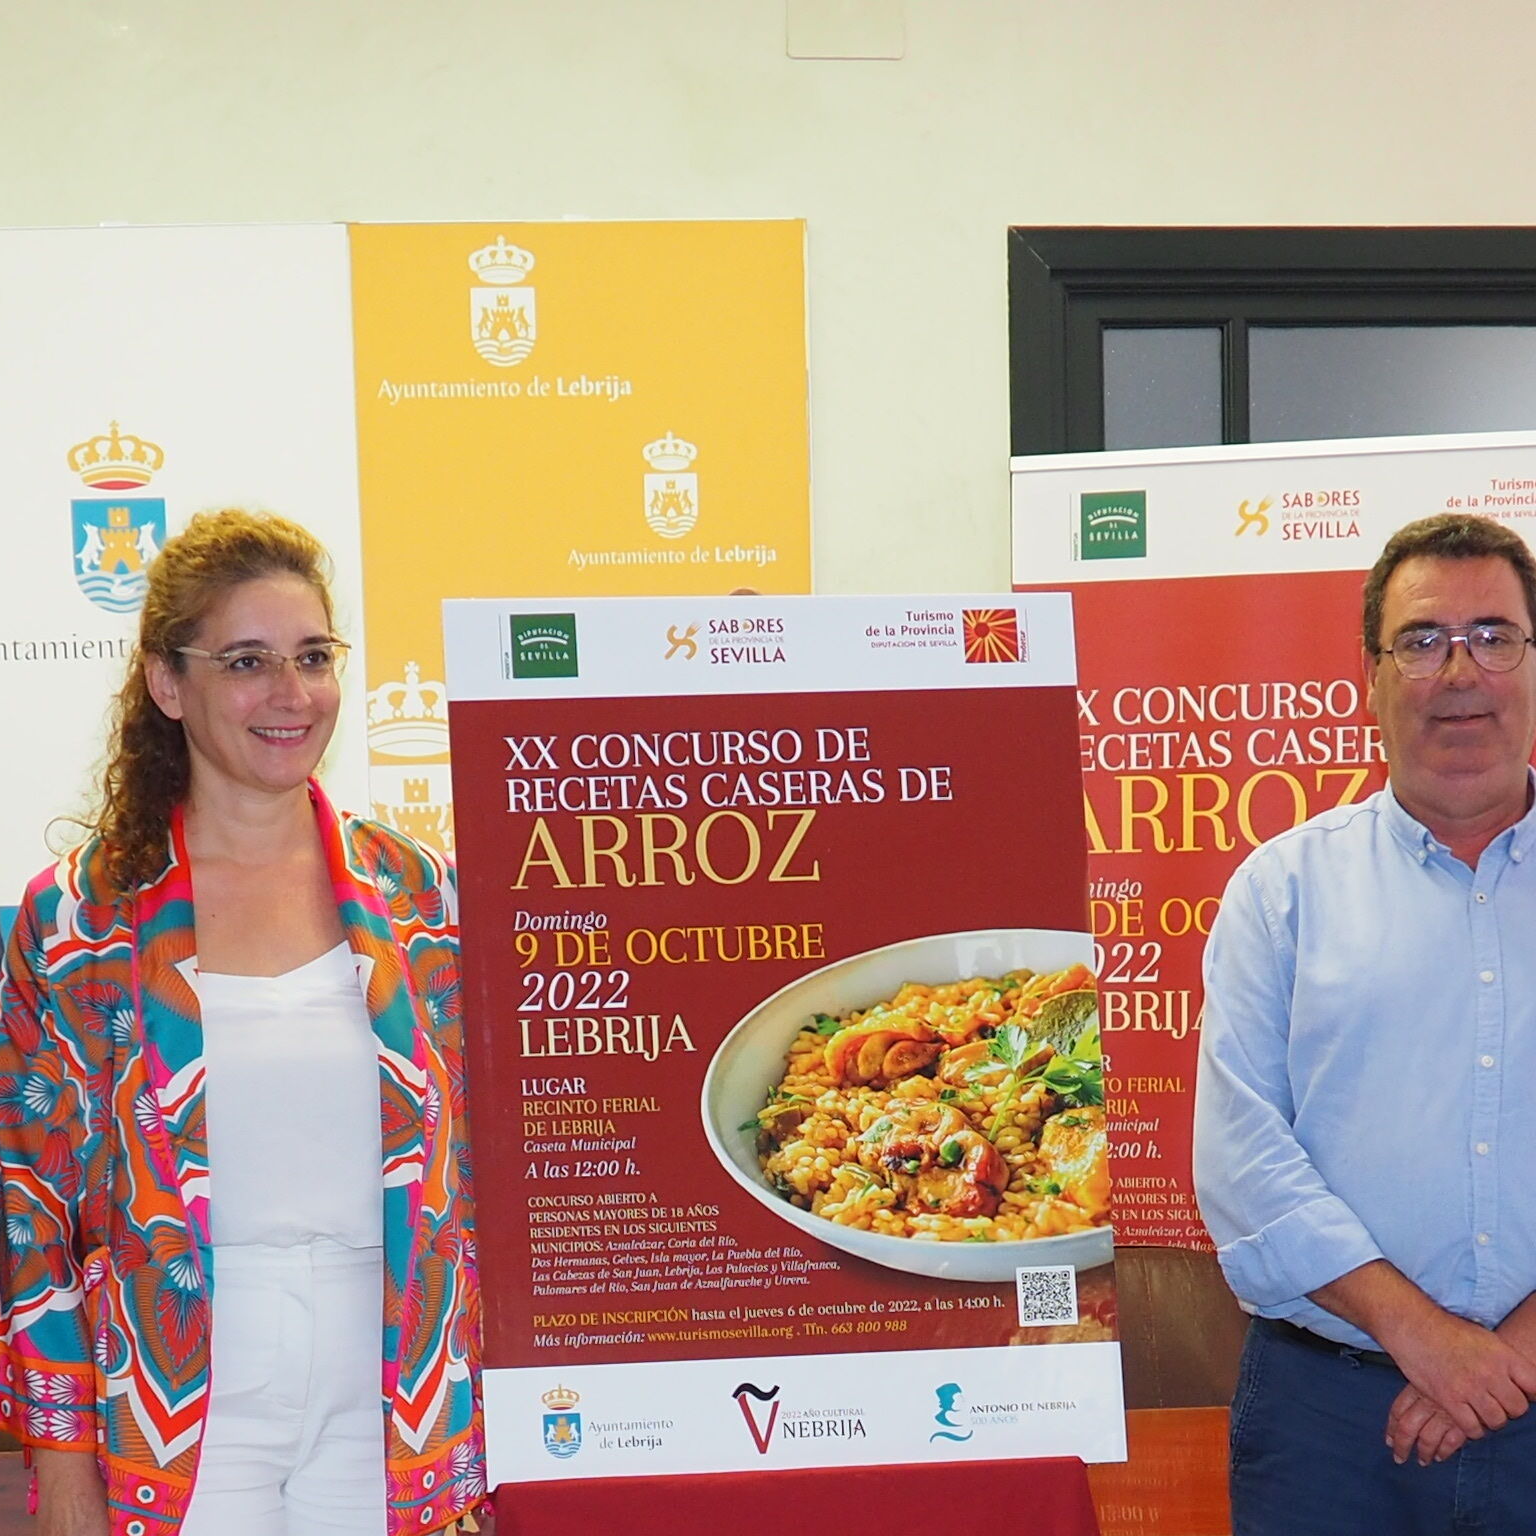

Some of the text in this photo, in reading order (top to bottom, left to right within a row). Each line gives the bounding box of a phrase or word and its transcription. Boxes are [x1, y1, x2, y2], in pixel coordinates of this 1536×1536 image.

[378, 374, 632, 405] Ayuntamiento de Lebrija
[1282, 490, 1361, 509] SABORES
[1447, 498, 1462, 508] de
[1468, 496, 1478, 507] la
[1282, 520, 1361, 540] SEVILLA
[568, 544, 776, 571] Ayuntamiento de Lebrija
[906, 610, 954, 622] Turismo
[709, 618, 784, 634] SABORES
[865, 623, 954, 636] de la Provincia
[710, 647, 786, 663] SEVILLA
[1113, 680, 1358, 726] CONCURSO
[504, 728, 870, 771] XX CONCURSO DE
[1080, 729, 1233, 772] ECETAS
[506, 767, 952, 812] RECETAS CASERAS DE
[510, 809, 820, 890] ARROZ
[513, 909, 608, 933] Domingo
[515, 923, 825, 968] 9 DE OCTUBRE
[518, 970, 631, 1012] 2022
[519, 1014, 696, 1061] LEBRIJA
[521, 1077, 587, 1096] LUGAR
[1128, 1077, 1185, 1093] FERIAL
[523, 1096, 660, 1117] RECINTO FERIAL
[524, 1119, 616, 1137] DE LEBRIJA
[524, 1137, 636, 1154] Caseta Municipal
[1146, 1140, 1162, 1159] h.
[525, 1158, 641, 1179] A las 12:00 h.
[1116, 1177, 1166, 1189] ABIERTO
[1169, 1177, 1177, 1188] A
[528, 1192, 658, 1208] CONCURSO ABIERTO A
[1112, 1193, 1167, 1205] MAYORES
[1170, 1193, 1187, 1204] DE
[529, 1203, 720, 1223] PERSONAS MAYORES DE 18 AÑOS
[1122, 1209, 1138, 1220] EN
[1141, 1208, 1164, 1220] LOS
[530, 1221, 717, 1239] RESIDENTES EN LOS SIGUIENTES
[530, 1241, 604, 1254] MUNICIPIOS:
[668, 1237, 696, 1248] Coria
[699, 1236, 715, 1247] del
[531, 1256, 551, 1268] Dos
[650, 1252, 670, 1264] Isla
[711, 1250, 724, 1261] La
[728, 1248, 762, 1260] Puebla
[764, 1247, 780, 1258] del
[532, 1271, 550, 1282] Las
[553, 1269, 595, 1281] Cabezas
[597, 1268, 610, 1279] de
[612, 1268, 632, 1279] San
[706, 1264, 722, 1275] Los
[725, 1262, 768, 1274] Palacios
[770, 1263, 778, 1275] y
[533, 1284, 588, 1296] Palomares
[590, 1282, 605, 1293] del
[631, 1281, 650, 1292] San
[651, 1280, 677, 1293] Juan
[680, 1279, 693, 1290] de
[695, 1276, 763, 1291] Aznalfarache
[764, 1277, 771, 1289] y
[533, 1314, 577, 1328] PLAZO
[580, 1313, 598, 1326] DE
[602, 1306, 689, 1325] INSCRIPCIÓN
[691, 1307, 726, 1321] hasta
[729, 1306, 741, 1319] el
[742, 1304, 784, 1322] jueves
[787, 1304, 795, 1317] 6
[799, 1303, 814, 1316] de
[817, 1302, 866, 1316] octubre
[869, 1301, 884, 1313] de
[924, 1301, 933, 1311] a
[935, 1298, 954, 1310] las
[958, 1297, 990, 1309] 14:00
[993, 1295, 1005, 1308] h.
[533, 1319, 907, 1349] Más información: www.turismosevilla.org Tfn. 663 800 988
[803, 1408, 821, 1418] AÑO
[822, 1407, 865, 1417] CULTURAL
[969, 1400, 1077, 1414] ANTONIO DE NEBRIJA
[588, 1418, 674, 1434] Ayuntamiento
[782, 1418, 867, 1440] NEBRIJA
[599, 1435, 663, 1451] de Lebrija
